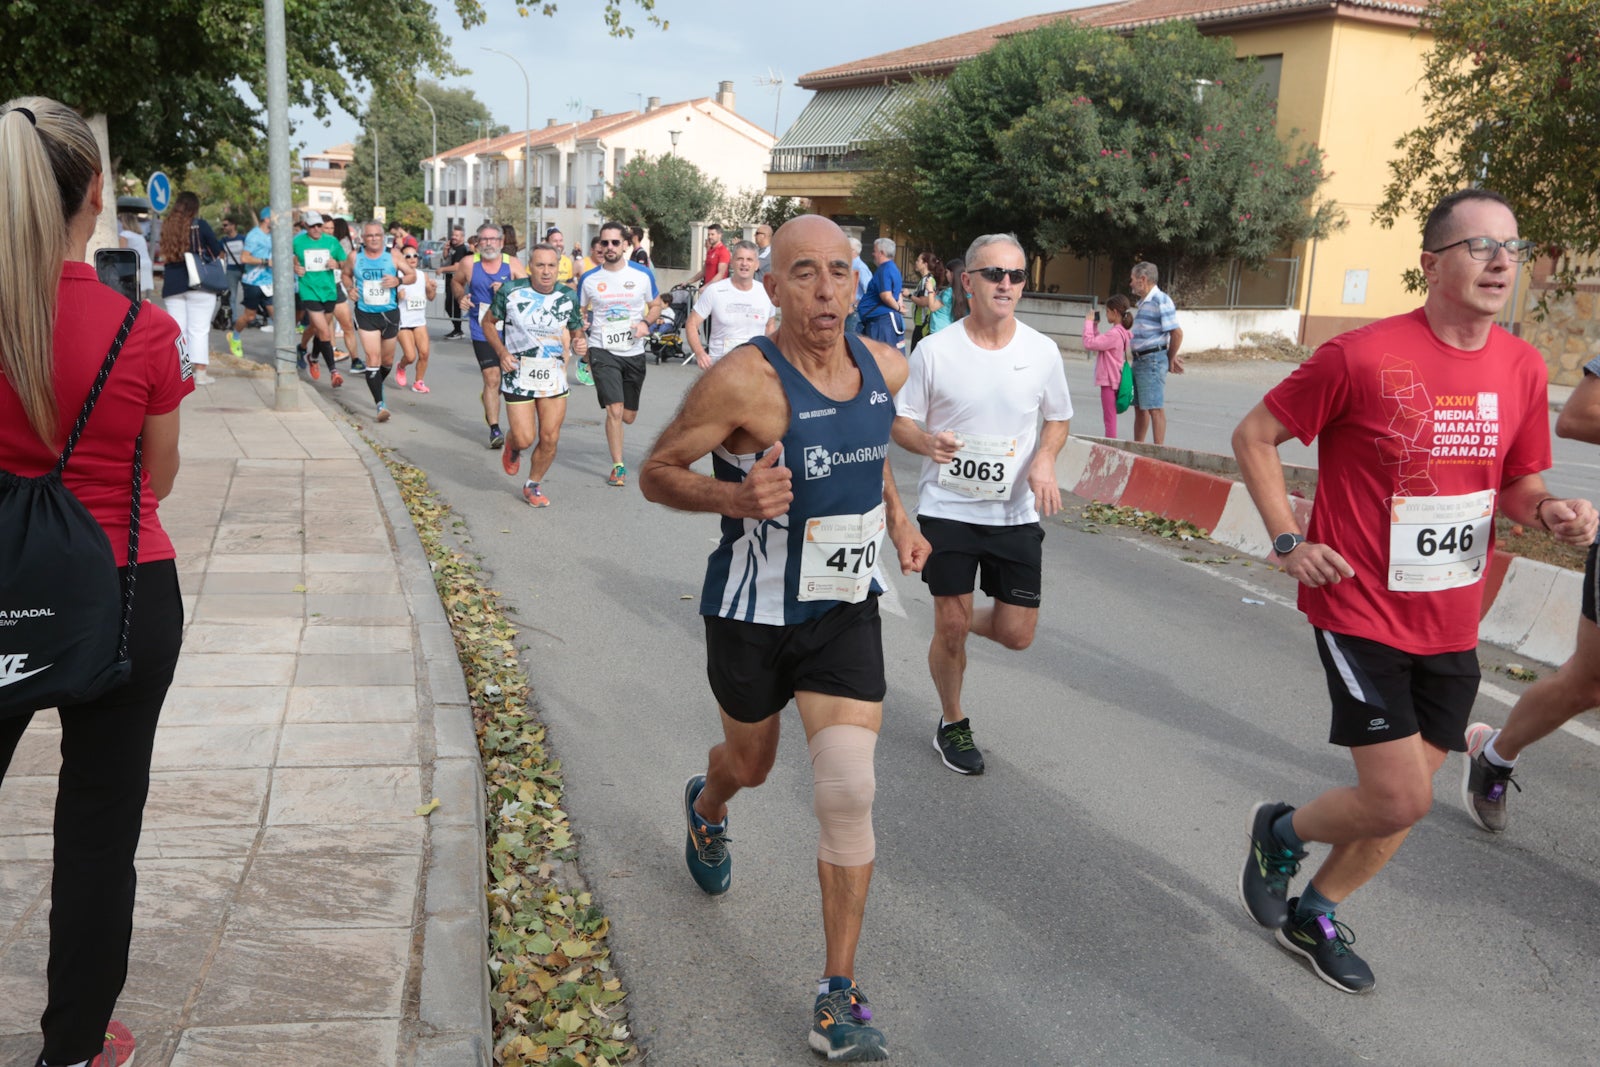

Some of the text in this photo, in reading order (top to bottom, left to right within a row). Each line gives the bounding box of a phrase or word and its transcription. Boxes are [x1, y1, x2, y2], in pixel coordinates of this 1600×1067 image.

[313, 256, 323, 264] 40
[369, 287, 385, 297] 539
[606, 330, 633, 345] 3072
[528, 369, 550, 380] 466
[1435, 395, 1475, 407] XXXIV
[1433, 410, 1475, 421] MEDIA
[1433, 421, 1499, 434] MARATÓN
[1433, 434, 1499, 446] CIUDAD DE
[1431, 446, 1497, 458] GRANADA
[949, 457, 1004, 482] 3063
[1417, 524, 1474, 557] 646
[826, 540, 876, 574] 470
[10, 608, 55, 618] NADAL
